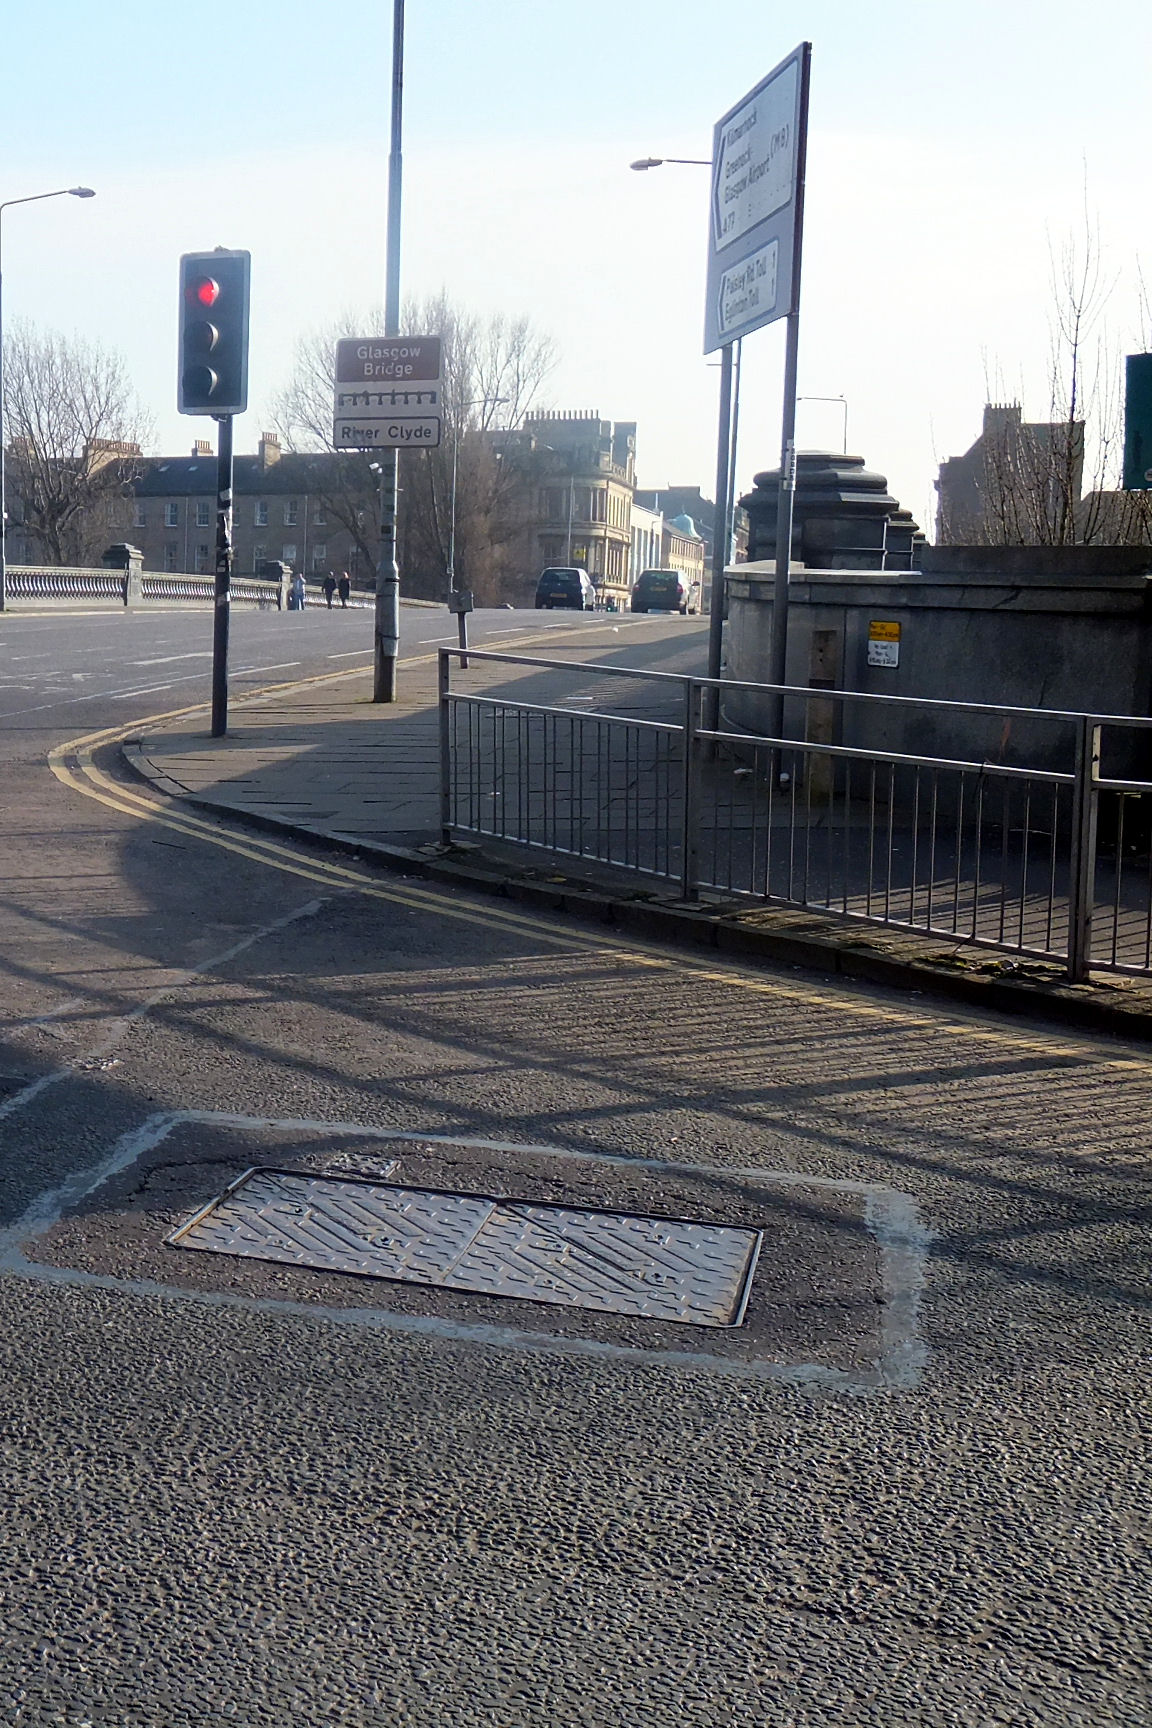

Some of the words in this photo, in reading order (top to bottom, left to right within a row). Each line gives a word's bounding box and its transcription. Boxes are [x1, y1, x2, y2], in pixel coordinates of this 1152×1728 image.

[750, 156, 769, 183] Airport
[357, 346, 421, 360] Glasgow
[363, 363, 413, 377] Bridge
[341, 426, 380, 439] River
[388, 425, 432, 441] Clyde
